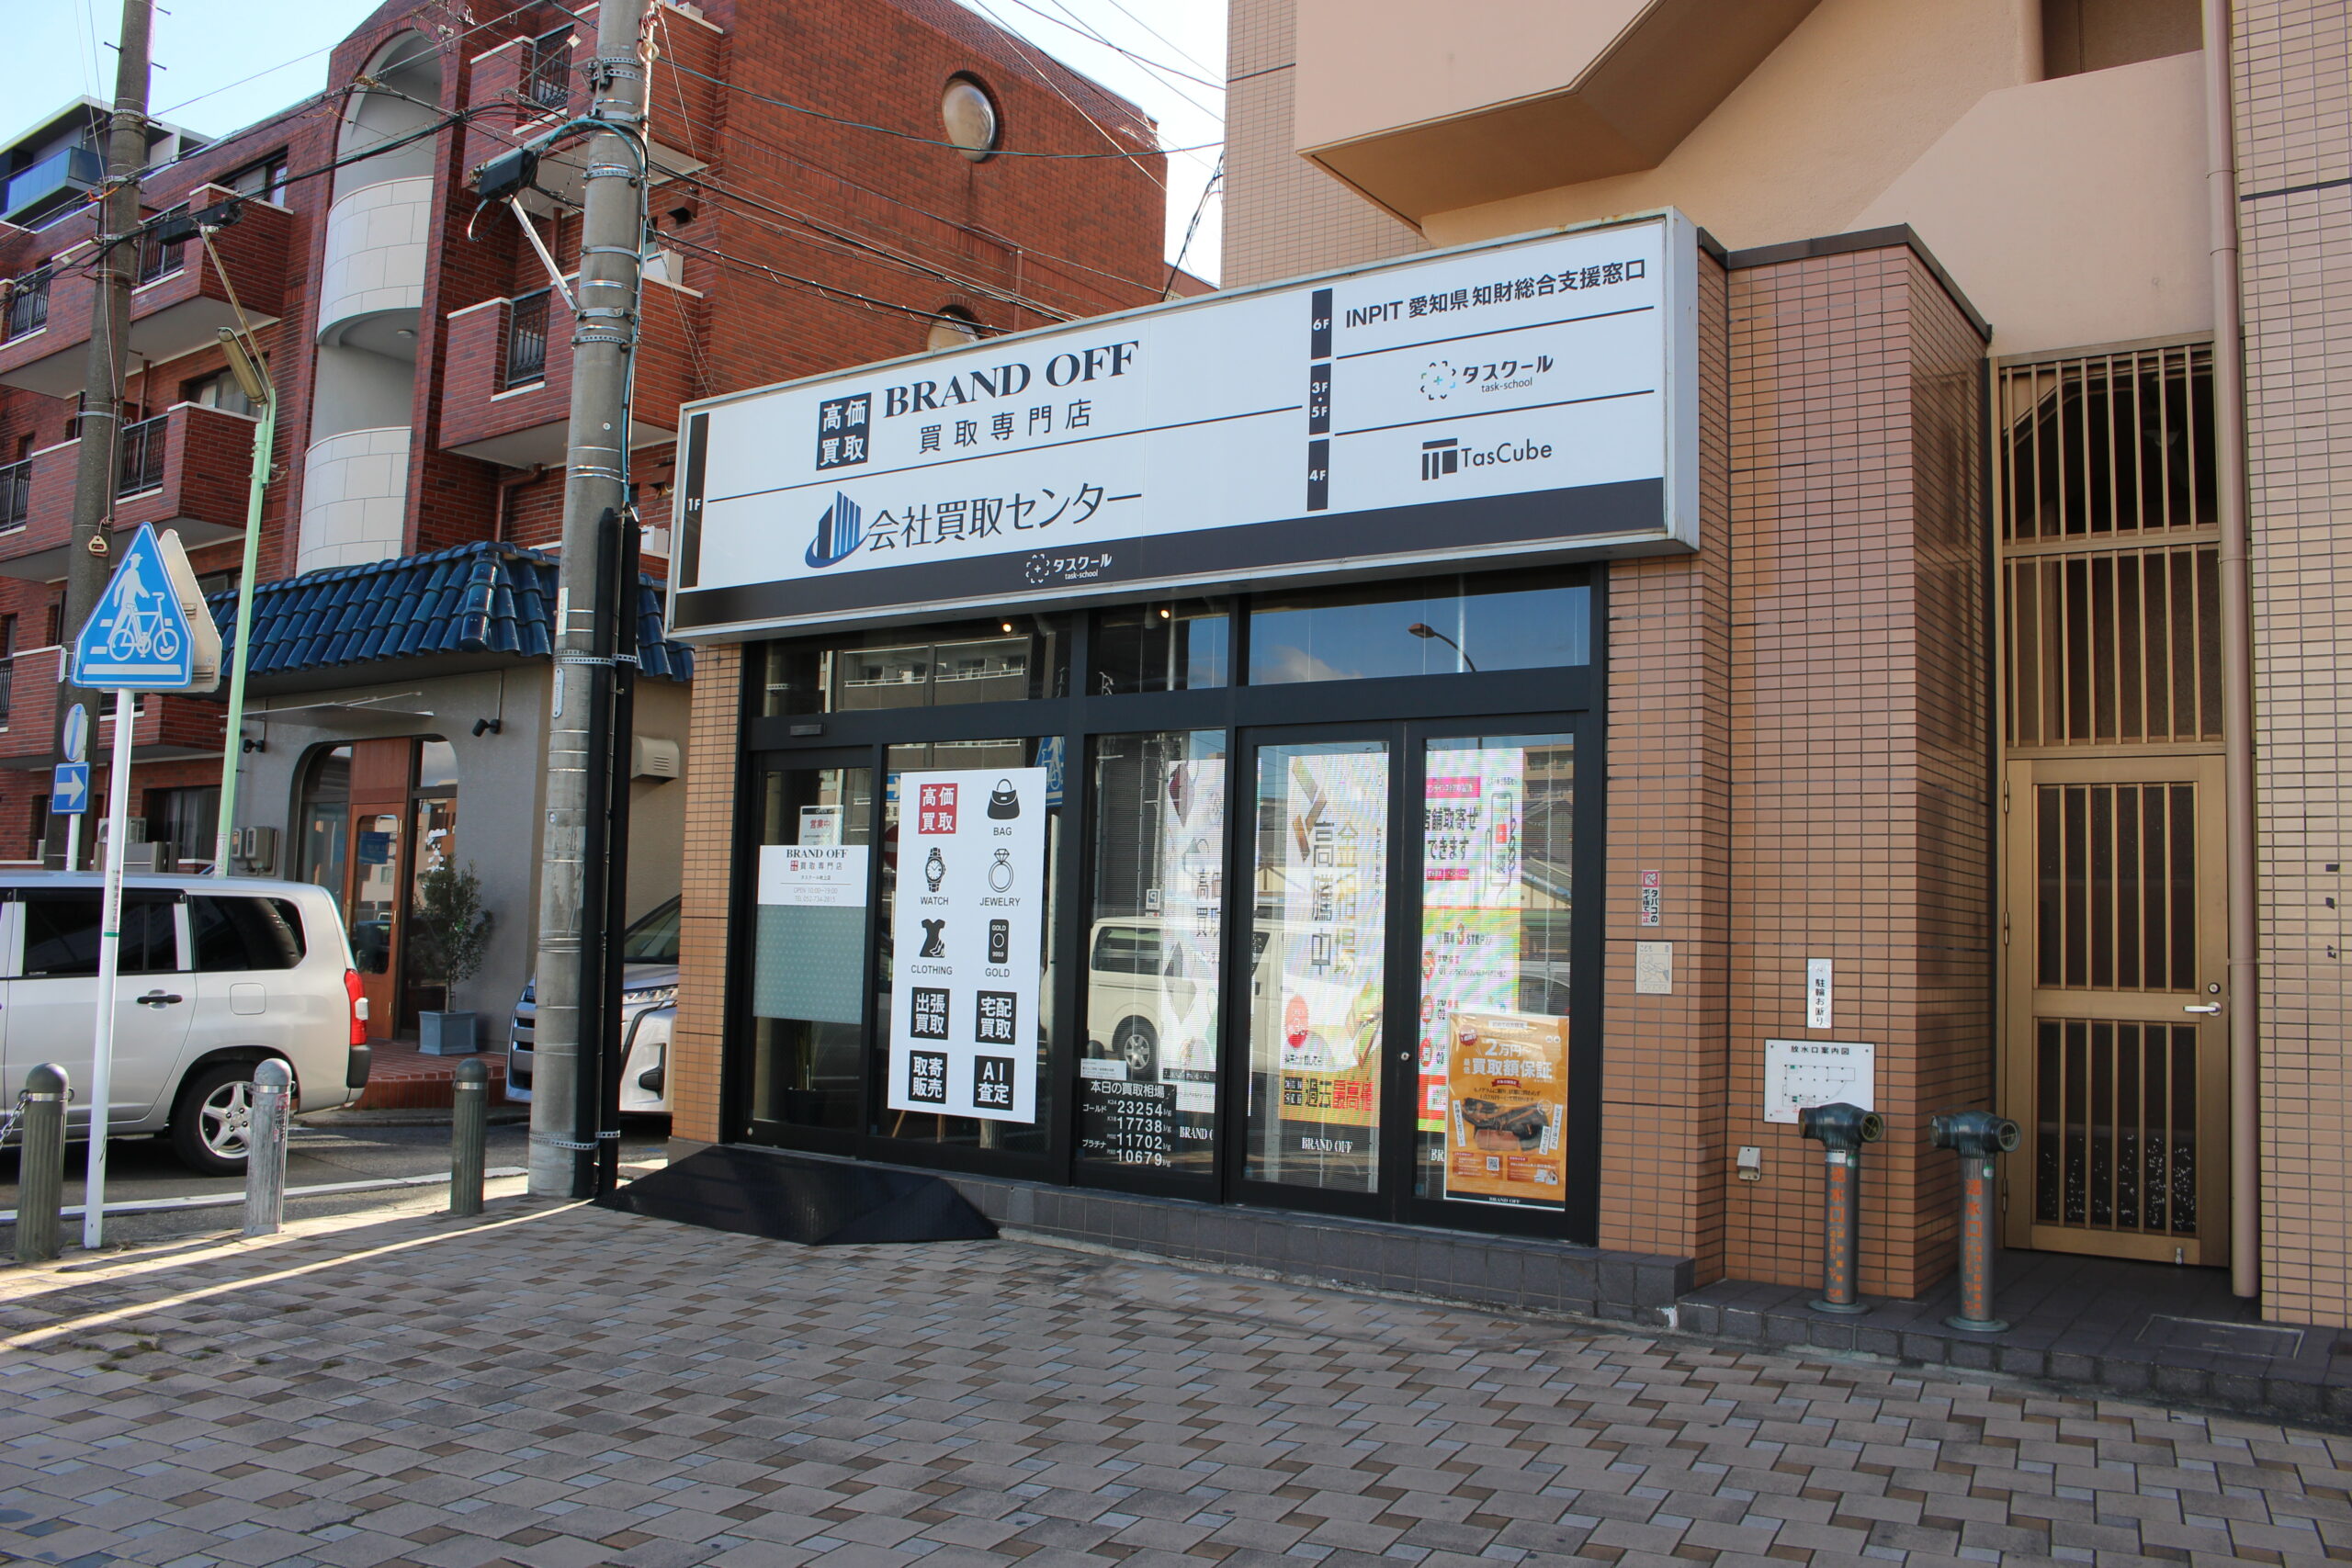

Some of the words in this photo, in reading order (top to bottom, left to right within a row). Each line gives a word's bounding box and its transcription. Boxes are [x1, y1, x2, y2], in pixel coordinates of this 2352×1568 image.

[1346, 301, 1404, 329] INPIT
[1312, 318, 1329, 332] 6F
[1463, 355, 1555, 384] タスクール
[884, 362, 1031, 418] BRAND
[1046, 341, 1140, 388] OFF
[1312, 381, 1329, 394] 3F
[1481, 376, 1532, 394] task-school
[823, 399, 866, 433] 高価
[1311, 406, 1328, 419] 5F
[919, 399, 1092, 455] 買取専門店
[820, 434, 865, 467] 買取
[1461, 438, 1553, 468] TasCube
[1309, 468, 1327, 482] 4F
[687, 498, 701, 512] 1F
[868, 482, 1143, 552] 会社買取センター
[1052, 553, 1113, 573] タスクール
[1064, 569, 1099, 581] task-school
[922, 785, 956, 807] 高価
[920, 811, 955, 832] 買取
[993, 827, 1012, 837] BAG
[786, 849, 823, 858] BRAND
[827, 849, 848, 858] OFF
[1428, 837, 1469, 860] できます
[800, 862, 842, 871] 買取専門店
[920, 897, 949, 907] WATCH
[979, 897, 1021, 908] JEWELRY
[1650, 889, 1658, 923] タバコの
[910, 964, 953, 976] CLOTHING
[985, 967, 1011, 978] GOLD
[915, 992, 945, 1014] 出張
[980, 996, 1012, 1018] 宅配
[1815, 978, 1825, 1026] 駐輪お断り
[914, 1014, 944, 1034] 買取
[979, 1018, 1012, 1040] 買取
[1791, 1045, 1849, 1055] 放水口案内図
[912, 1055, 944, 1077] 取寄
[1472, 1058, 1553, 1079] 買取額保証
[912, 1077, 943, 1099] 販売
[978, 1082, 1010, 1104] 査定
[1091, 1079, 1165, 1099] 本日の買取相場
[1082, 1103, 1107, 1114] ゴールド
[1117, 1100, 1163, 1117] 23254
[1116, 1116, 1162, 1134] 17738
[1179, 1126, 1208, 1140] BRAND
[1082, 1139, 1107, 1149] プラチナ
[1116, 1133, 1162, 1150] 11702
[1301, 1137, 1333, 1152] BRAND
[1334, 1140, 1353, 1154] OFF
[1116, 1149, 1163, 1167] 10679
